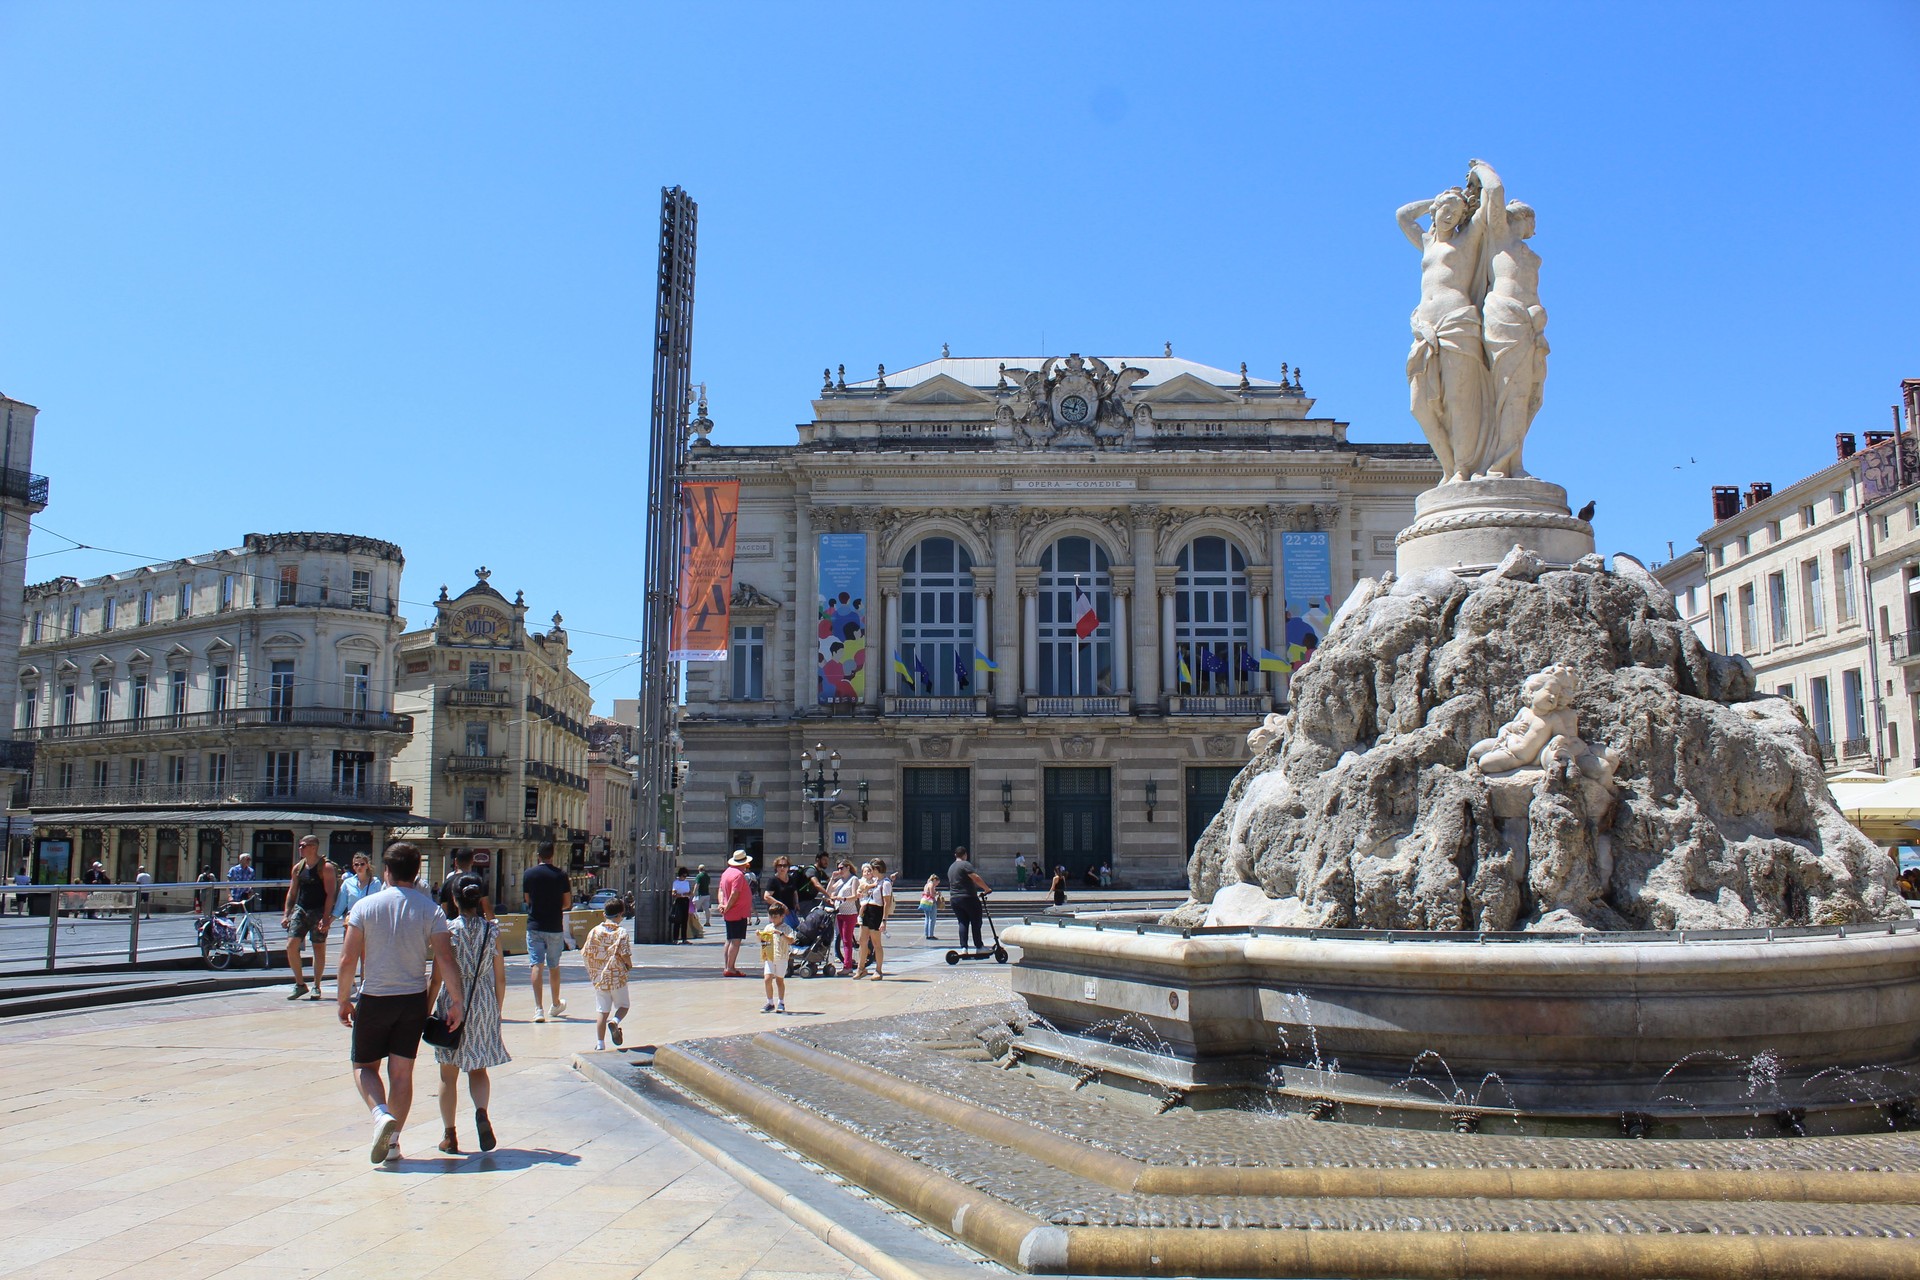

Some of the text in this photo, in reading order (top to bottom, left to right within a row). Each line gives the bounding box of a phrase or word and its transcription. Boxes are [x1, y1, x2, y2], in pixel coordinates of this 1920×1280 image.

[1285, 534, 1326, 546] 22 23
[454, 606, 480, 627] GRAND
[465, 620, 496, 634] MIDI
